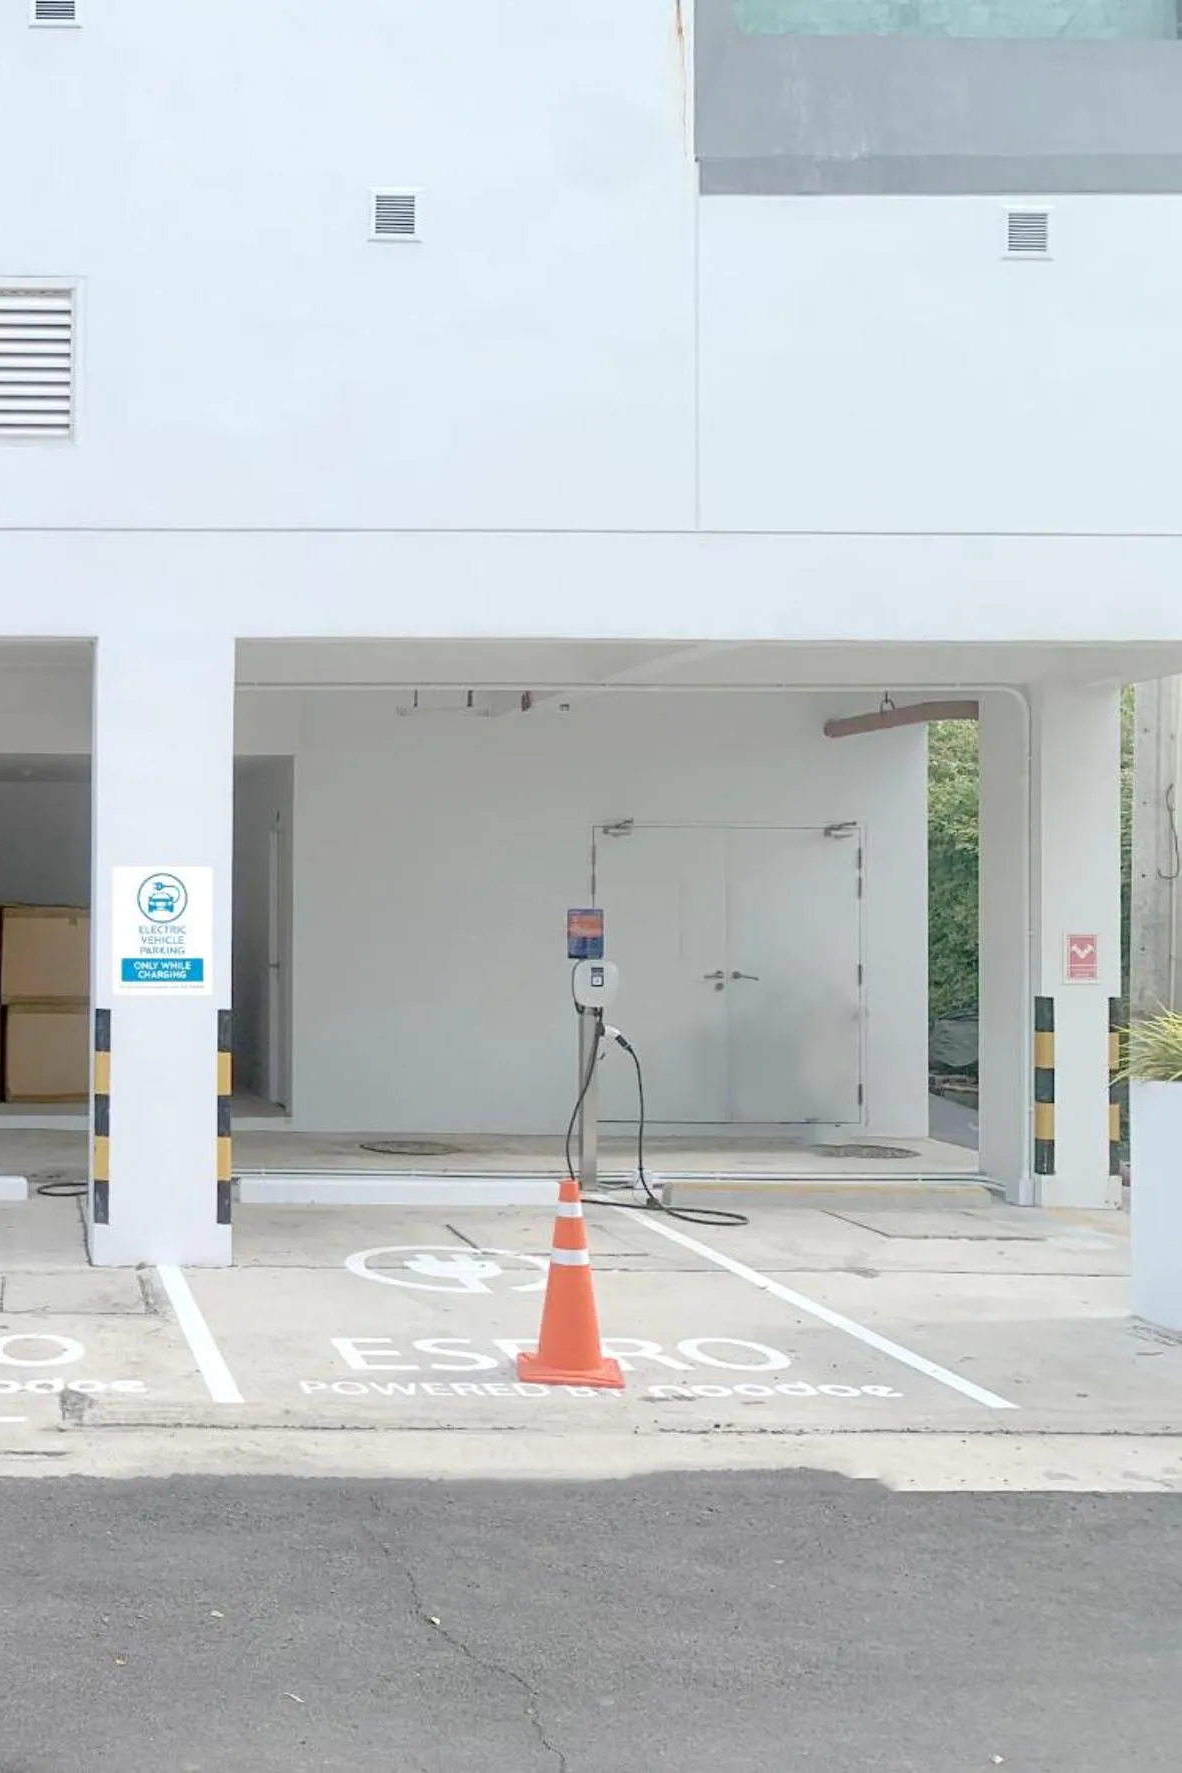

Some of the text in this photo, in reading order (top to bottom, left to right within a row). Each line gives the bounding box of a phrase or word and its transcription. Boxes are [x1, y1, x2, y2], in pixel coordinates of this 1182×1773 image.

[138, 925, 187, 934] ELECTRIC
[141, 936, 185, 945] VEHICLE
[139, 946, 186, 955] PARKING
[133, 960, 192, 970] ONLY WHILE
[138, 970, 187, 979] CHARGING
[299, 1380, 552, 1397] POWERED
[648, 1380, 904, 1398] noodoe
